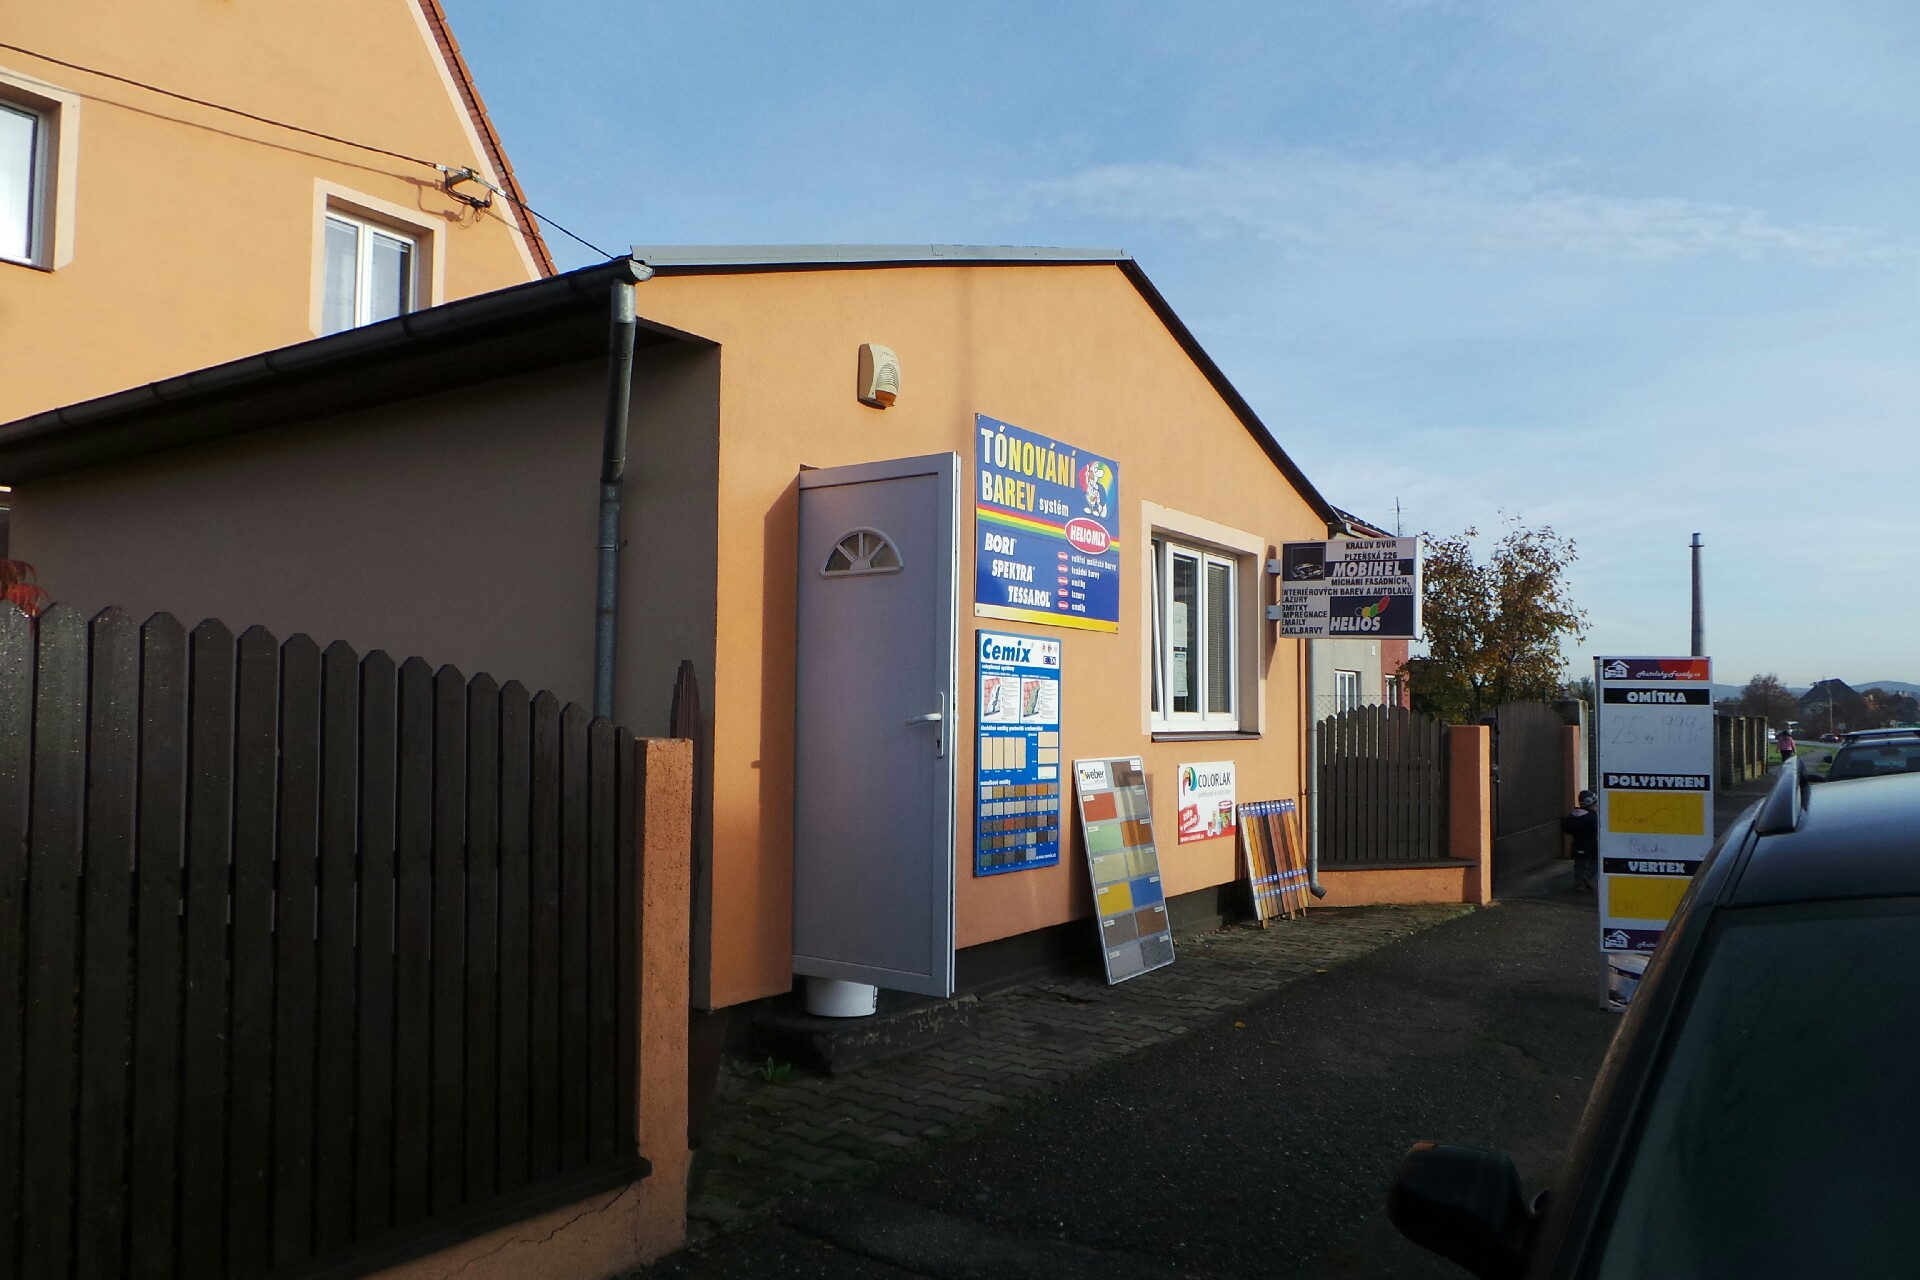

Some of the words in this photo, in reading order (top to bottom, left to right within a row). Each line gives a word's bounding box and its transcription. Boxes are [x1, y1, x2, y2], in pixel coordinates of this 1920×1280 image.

[981, 425, 1077, 489] TÓNOVÁNÍ
[982, 470, 1036, 512] BAREV
[1039, 498, 1069, 517] systém
[1070, 525, 1106, 548] HELIOMIX
[1383, 552, 1397, 560] 226
[1333, 561, 1401, 577] MOBIHEL
[1341, 588, 1364, 596] BAREV
[1366, 587, 1371, 595] A
[1329, 616, 1380, 632] HELIOS
[982, 638, 1032, 663] Cemix
[1627, 690, 1687, 703] OMÍTKA
[1085, 769, 1105, 780] weber
[1198, 772, 1231, 788] COLORLAK
[1608, 775, 1705, 788] POLYSTYREN
[1628, 861, 1686, 874] VERTEX
